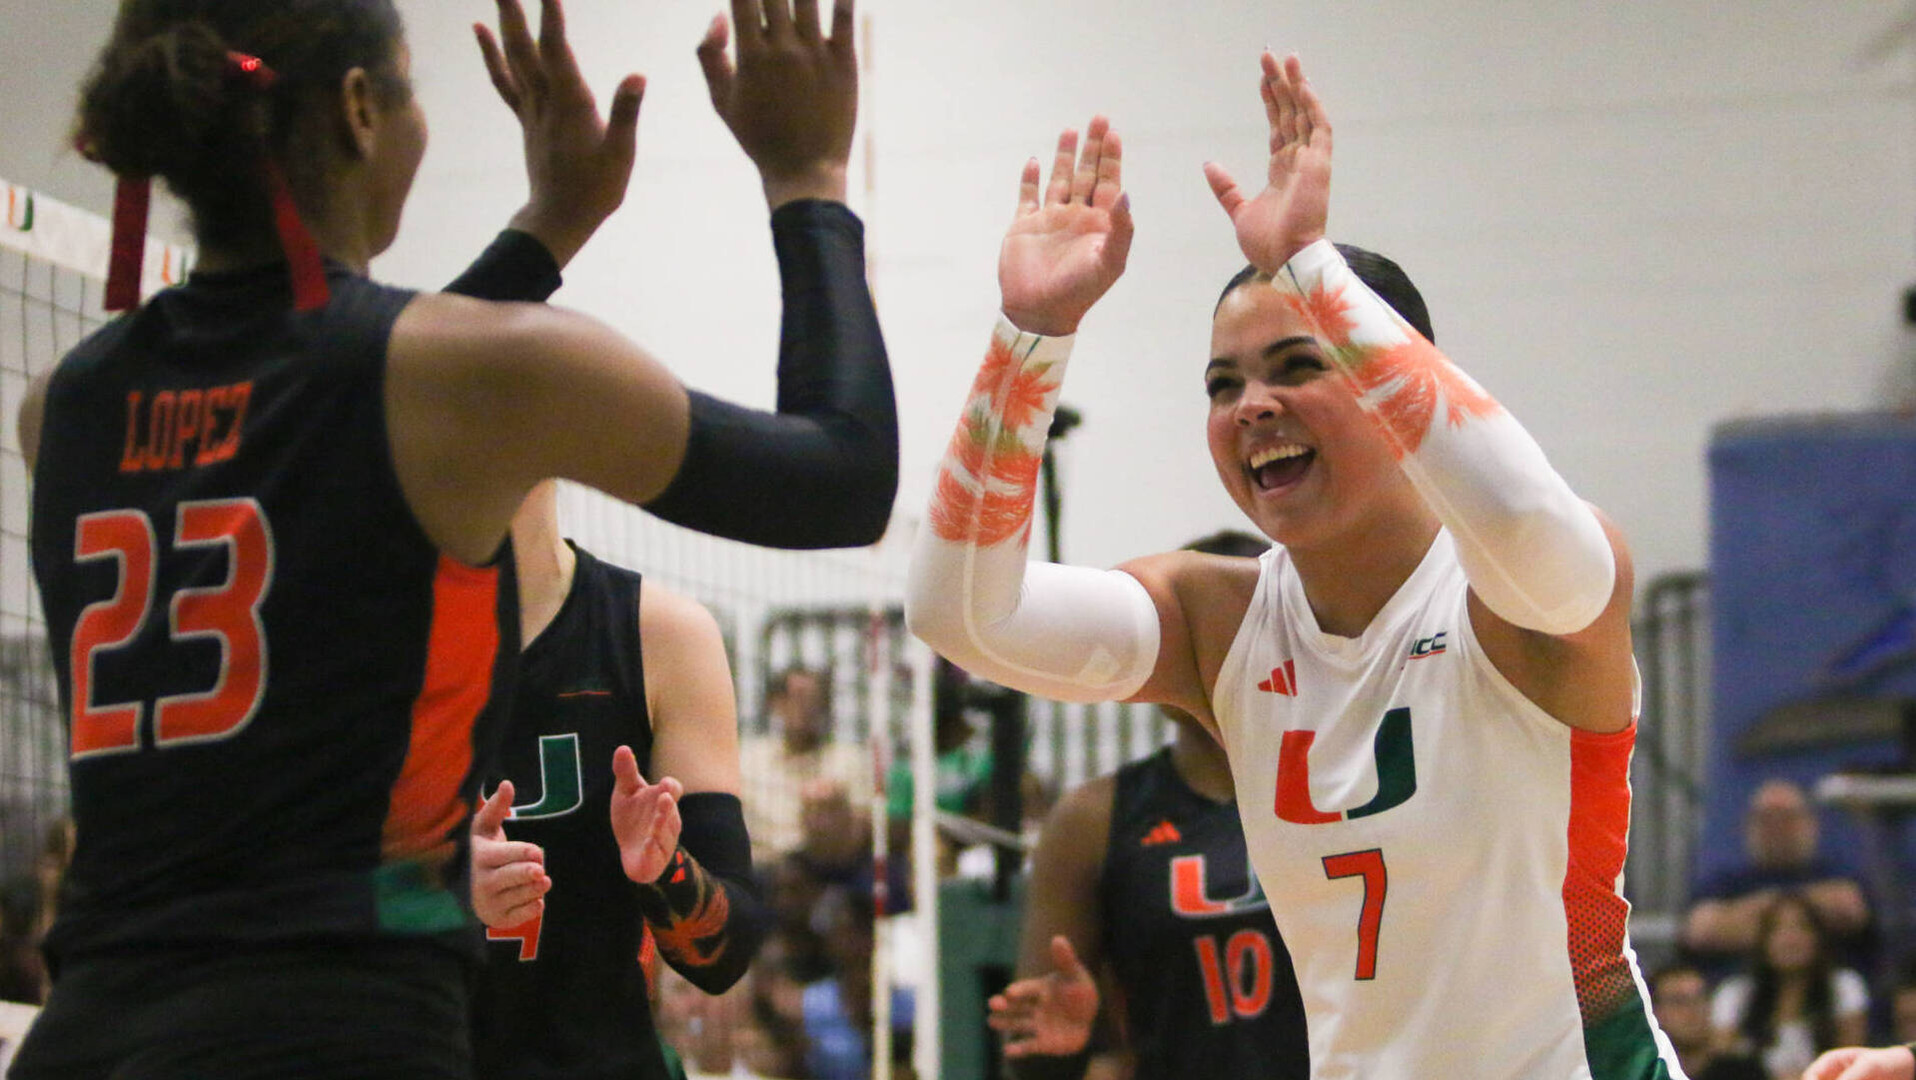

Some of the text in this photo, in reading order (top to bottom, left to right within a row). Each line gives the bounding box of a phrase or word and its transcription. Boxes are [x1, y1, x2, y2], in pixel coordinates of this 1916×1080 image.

[119, 381, 253, 472] LOPEZ
[70, 497, 274, 760] 23
[1274, 707, 1417, 824] U
[1321, 848, 1388, 980] 7
[1194, 929, 1273, 1024] 10
